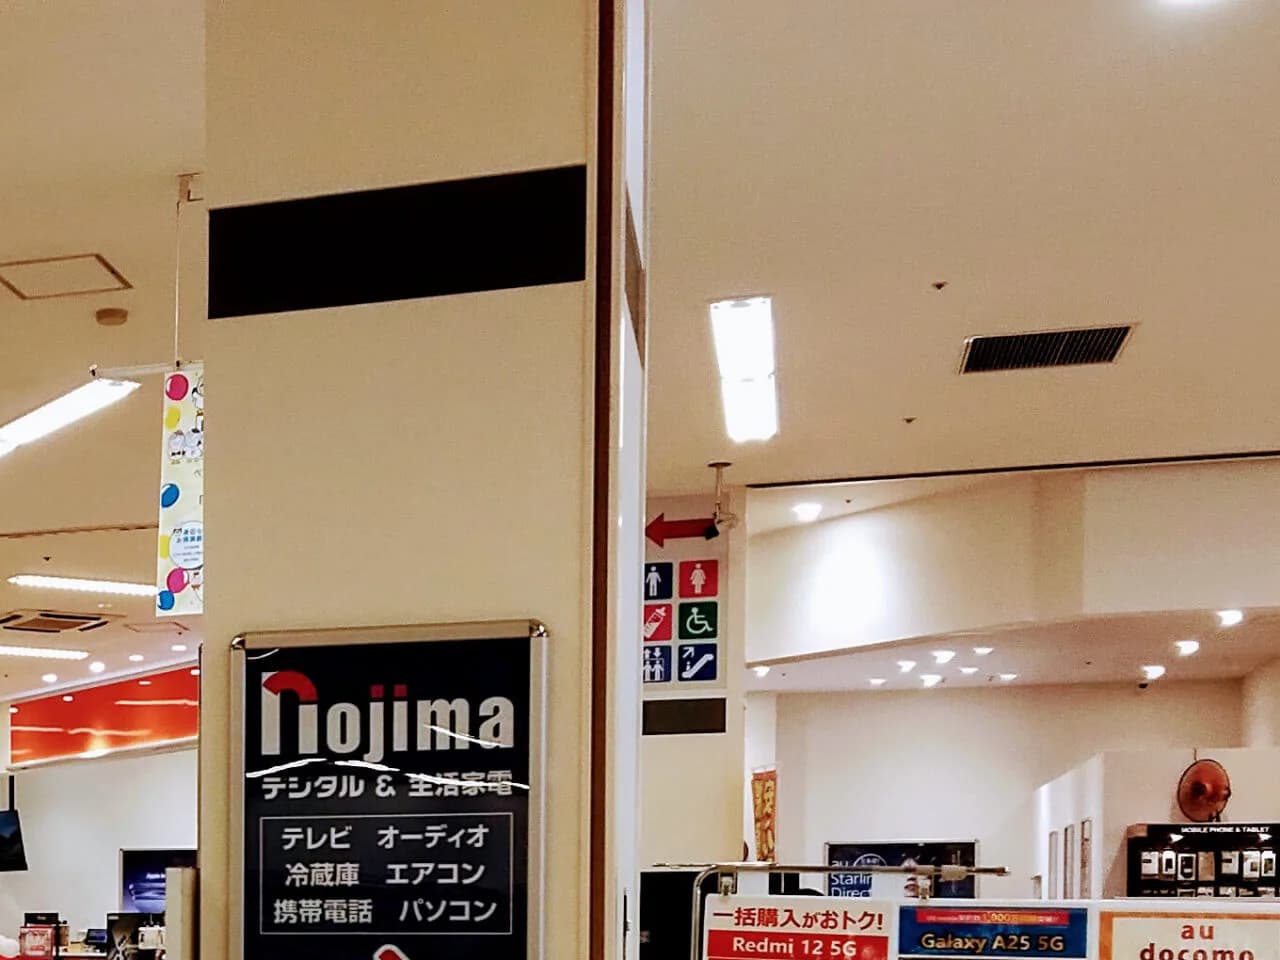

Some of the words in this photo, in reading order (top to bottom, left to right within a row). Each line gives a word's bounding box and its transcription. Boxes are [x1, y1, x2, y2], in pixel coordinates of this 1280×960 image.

[260, 671, 514, 762] nojima
[376, 774, 396, 797] &
[280, 826, 353, 851] テレビ
[376, 824, 490, 850] オーディオ
[285, 862, 360, 886] 冷蔵庫
[385, 862, 486, 886] エアコン
[273, 898, 372, 924] 携帯電話
[399, 898, 497, 923] パソコン
[713, 907, 884, 930] 一括購入がおトク!
[921, 933, 986, 953] Galaxy
[992, 935, 1030, 950] A25
[1038, 936, 1064, 951] 5G
[1182, 924, 1214, 941] au
[733, 937, 793, 955] Redmi
[801, 939, 822, 956] 12
[830, 941, 857, 957] 5G
